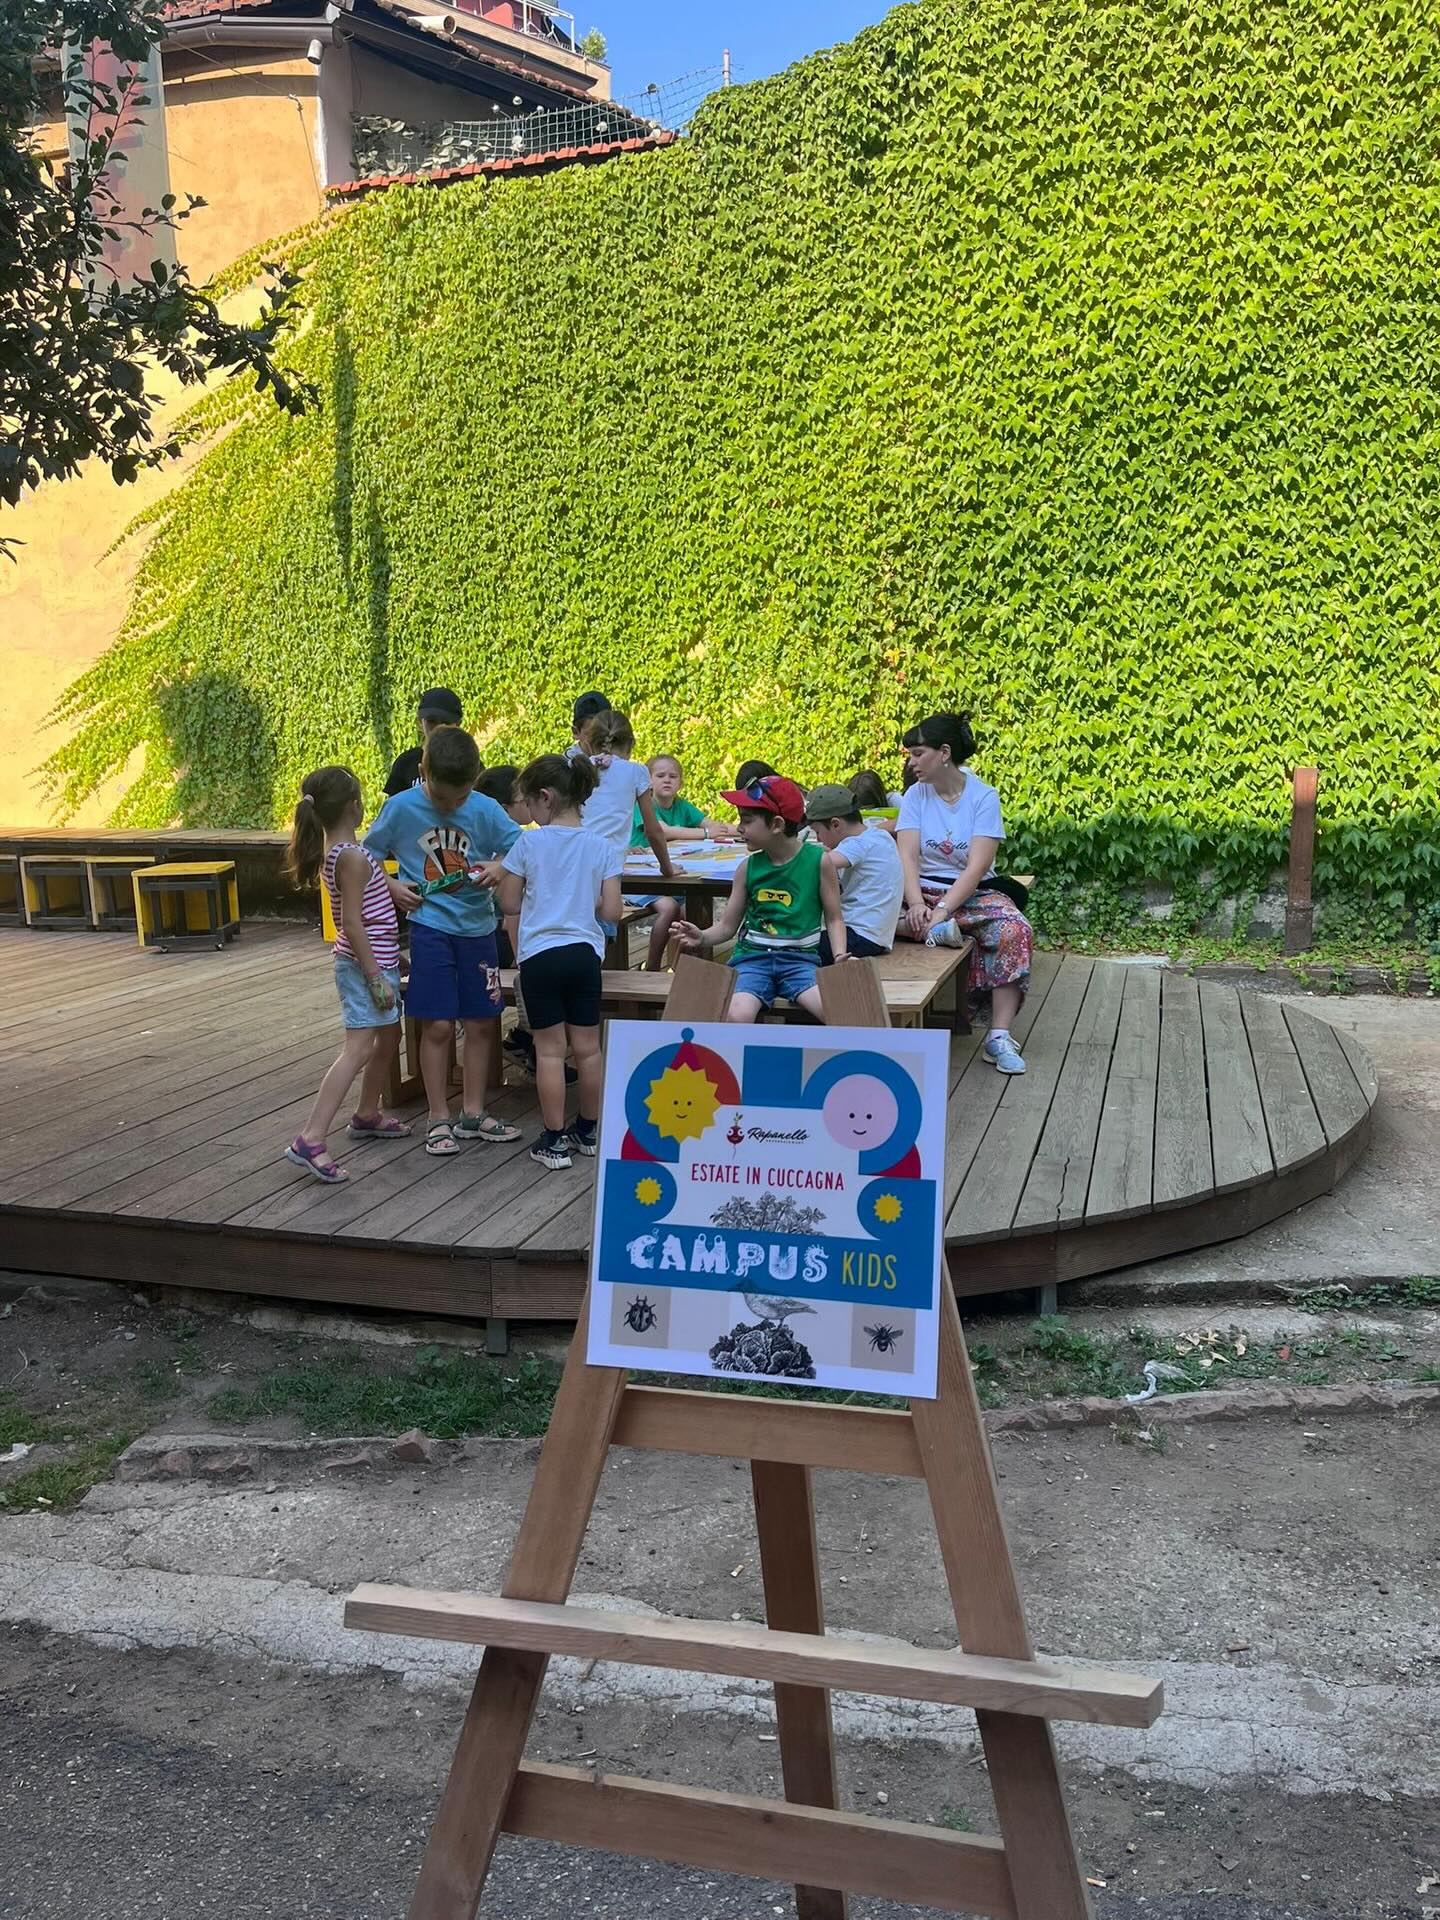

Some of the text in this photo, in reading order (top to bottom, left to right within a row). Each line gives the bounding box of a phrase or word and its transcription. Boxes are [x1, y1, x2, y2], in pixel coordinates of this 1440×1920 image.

[416, 828, 472, 877] FILA
[747, 1127, 811, 1144] Rapanello
[691, 1163, 845, 1191] ESTATE IN CUCCAGNA
[626, 1229, 898, 1290] CAMPUS KIDS
